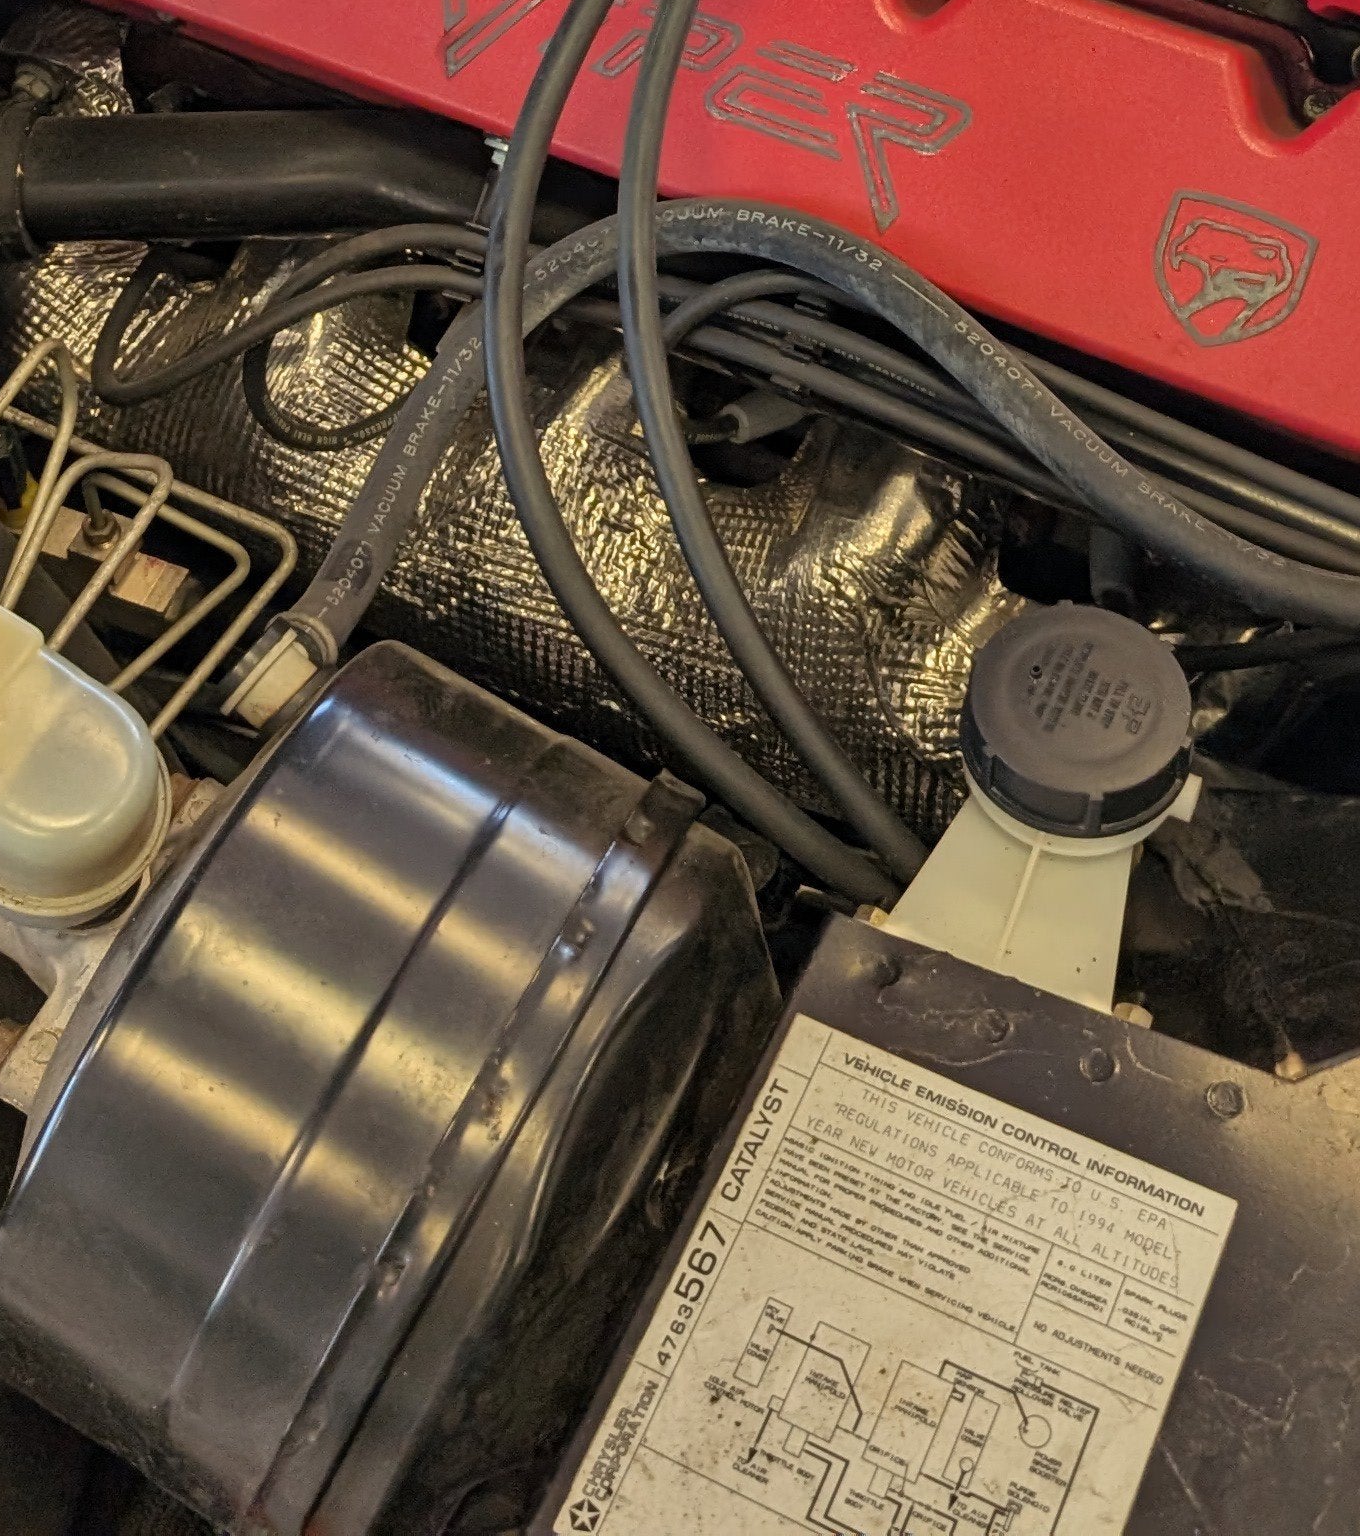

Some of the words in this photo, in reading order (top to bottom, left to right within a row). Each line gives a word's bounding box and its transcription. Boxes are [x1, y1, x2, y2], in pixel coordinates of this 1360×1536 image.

[736, 208, 884, 273] BRAKE-11/32
[953, 319, 1043, 401] 5204071
[1049, 403, 1129, 478] VACUUM
[325, 540, 373, 608] 5204071
[367, 463, 409, 535] VACUUM
[402, 335, 483, 458] BRAKE-11/32
[720, 1078, 791, 1203] CATALYST
[834, 1102, 940, 1158] REGULATIONS
[944, 1150, 1040, 1203] APPLICABLE
[1048, 1195, 1070, 1215] TO
[1077, 1208, 1116, 1235] 1994
[1121, 1227, 1176, 1261] MODEL
[841, 1052, 913, 1092] VEHICLE
[913, 1084, 998, 1129] EMISSION
[1000, 1121, 1083, 1166] CONTROL
[1085, 1156, 1206, 1218] INFORMATION
[859, 1088, 899, 1115] THIS
[904, 1108, 971, 1147] VEHICLE
[976, 1138, 1055, 1183] CONFORMS
[1060, 1174, 1083, 1195] TO
[1135, 1206, 1169, 1232] EPA
[763, 1187, 802, 1210] SERVICE
[802, 1206, 837, 1226] MANUAL
[838, 1222, 894, 1252] PROCEDURES
[895, 1248, 914, 1262] MAY
[916, 1257, 956, 1281] VIOLATE
[768, 1177, 827, 1209] ADJUSTMENTS
[828, 1204, 852, 1220] MADE
[854, 1216, 867, 1227] BY
[869, 1223, 899, 1242] OTHER
[901, 1237, 925, 1254] THAN
[925, 1249, 972, 1275] APPROVED
[777, 1156, 811, 1177] MANUAL
[812, 1172, 831, 1186] FOR
[832, 1181, 867, 1202] PROPER
[924, 1223, 944, 1237] AND
[945, 1232, 975, 1251] OTHER
[976, 1246, 1032, 1276] ADDITIONAL
[782, 1146, 806, 1162] HAVE
[807, 1157, 831, 1174] BEEN
[832, 1169, 867, 1190] PRESET
[868, 1185, 881, 1196] AT
[883, 1192, 901, 1205] THE
[949, 1222, 968, 1236] SEE
[971, 1231, 989, 1245] THE
[991, 1240, 1031, 1264] SERVICE
[799, 1216, 818, 1230] AND
[818, 1225, 847, 1244] STATE
[803, 1115, 844, 1142] YEAR
[847, 1135, 879, 1157] NEW
[884, 1150, 936, 1182] MOTOR
[939, 1175, 1018, 1220] VEHICLES
[1024, 1212, 1045, 1231] AT
[1052, 1224, 1083, 1248] ALL
[1089, 1240, 1181, 1290] ALTITUDES
[818, 1151, 861, 1175] IGNITION
[862, 1171, 896, 1191] TIMING
[897, 1186, 917, 1200] AND
[919, 1196, 942, 1212] IDLE
[943, 1206, 968, 1223] FUEL
[980, 1222, 999, 1237] AIR
[1000, 1231, 1041, 1255] MIXTURE
[824, 1241, 864, 1264] PARKING
[865, 1259, 895, 1278] BRAKE
[896, 1273, 921, 1290] WHEN
[922, 1285, 974, 1314] SERVICING
[1079, 1268, 1113, 1289] LITER
[1123, 1287, 1154, 1306] SPARK
[1156, 1302, 1188, 1322] PLUGS
[738, 1397, 766, 1415] MOTOR
[1032, 1319, 1048, 1334] NO
[1050, 1327, 1122, 1367] ADJUSTMENTS
[1123, 1360, 1165, 1386] NEEDED
[583, 1402, 634, 1498] CHRYSLER
[595, 1380, 660, 1502] CORPORATION
